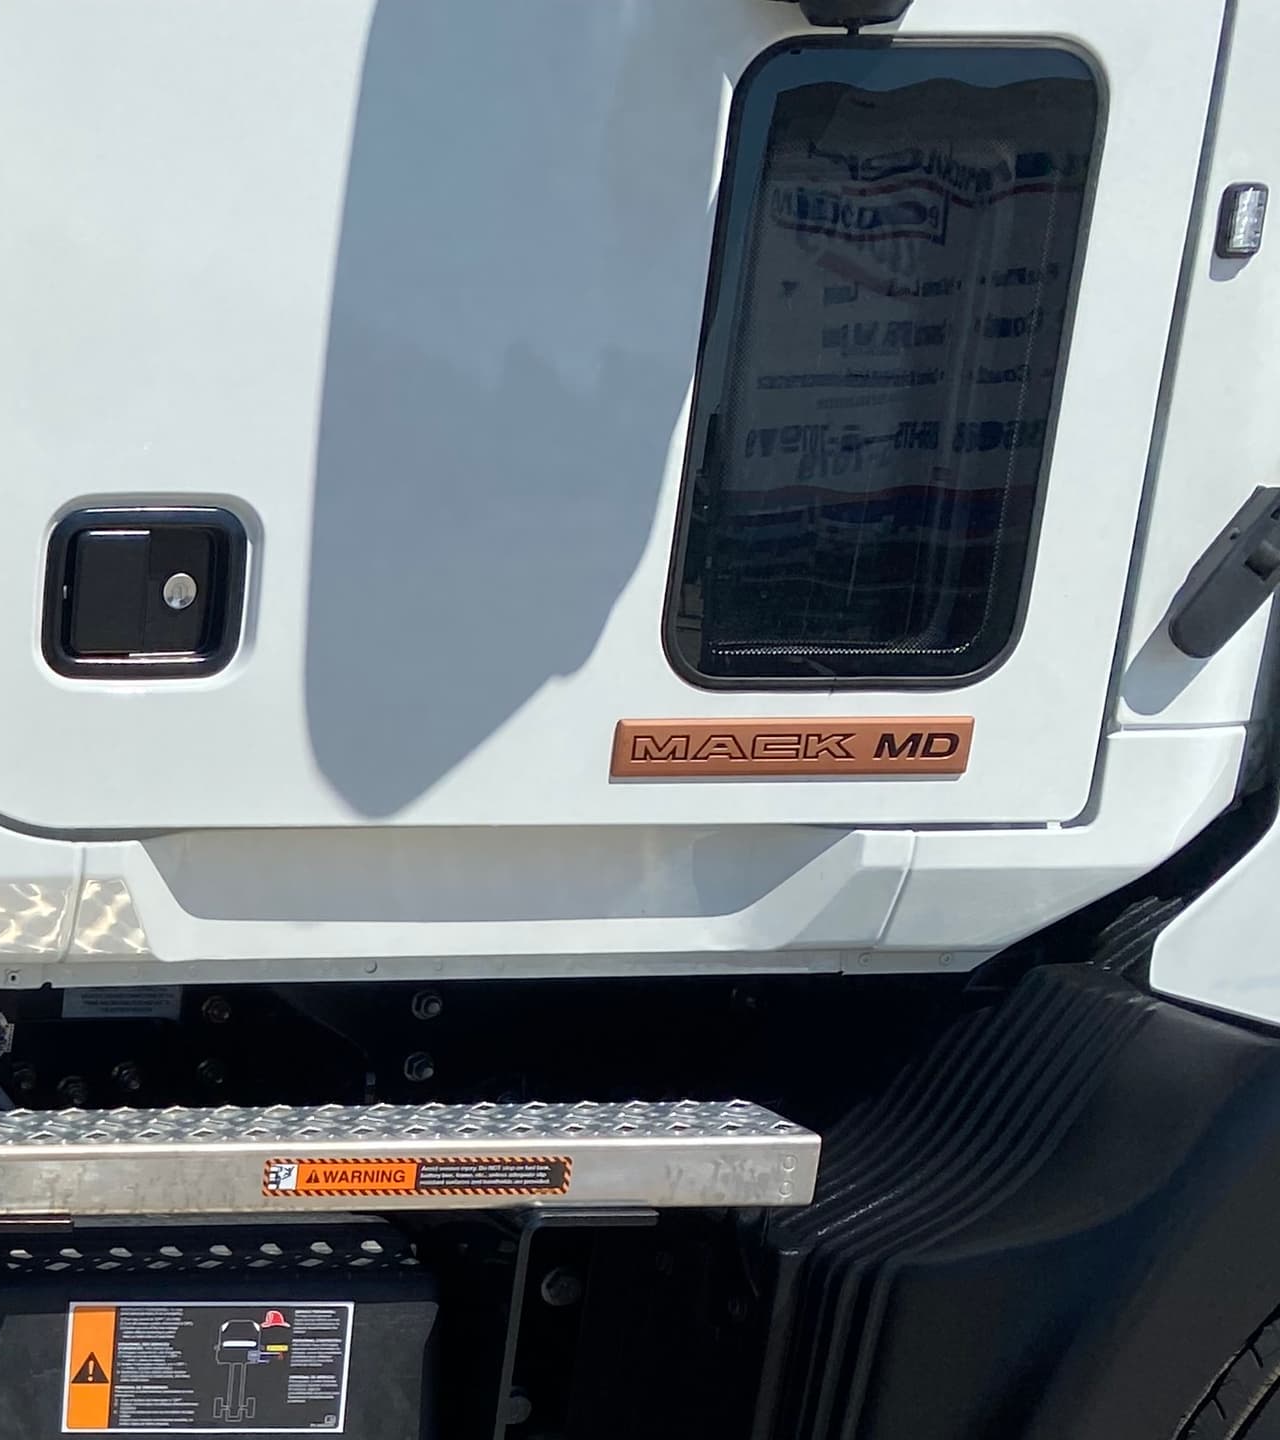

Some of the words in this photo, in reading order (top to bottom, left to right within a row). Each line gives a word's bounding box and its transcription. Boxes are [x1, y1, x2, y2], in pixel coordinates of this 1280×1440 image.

[631, 733, 856, 762] MACK
[873, 732, 960, 760] MD
[323, 1170, 406, 1183] WARNING
